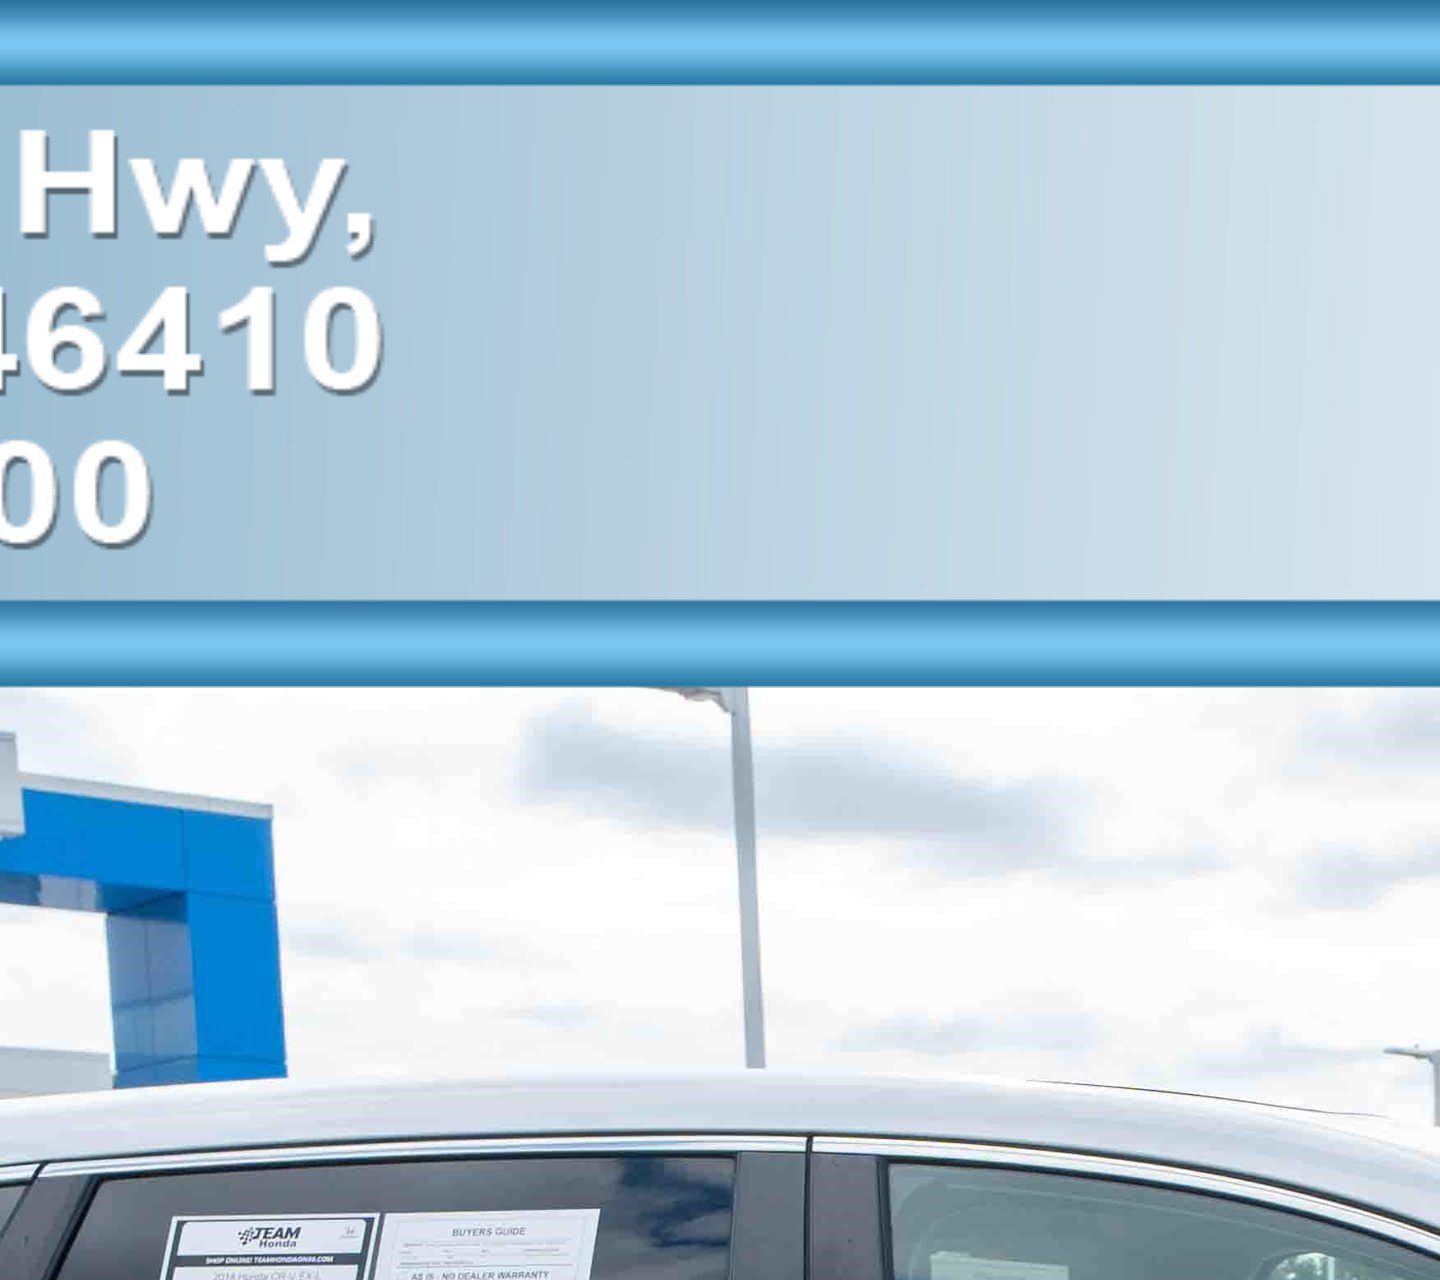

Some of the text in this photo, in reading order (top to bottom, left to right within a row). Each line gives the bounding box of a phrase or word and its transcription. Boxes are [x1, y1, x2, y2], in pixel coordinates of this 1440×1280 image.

[253, 1226, 302, 1240] TEAM
[451, 1226, 528, 1237] BUYERS GUIDE
[259, 1239, 297, 1249] Honda
[410, 1272, 424, 1280] AS
[440, 1272, 456, 1280] NO
[457, 1271, 494, 1280] DEALER
[496, 1270, 550, 1280] WARRANTY
